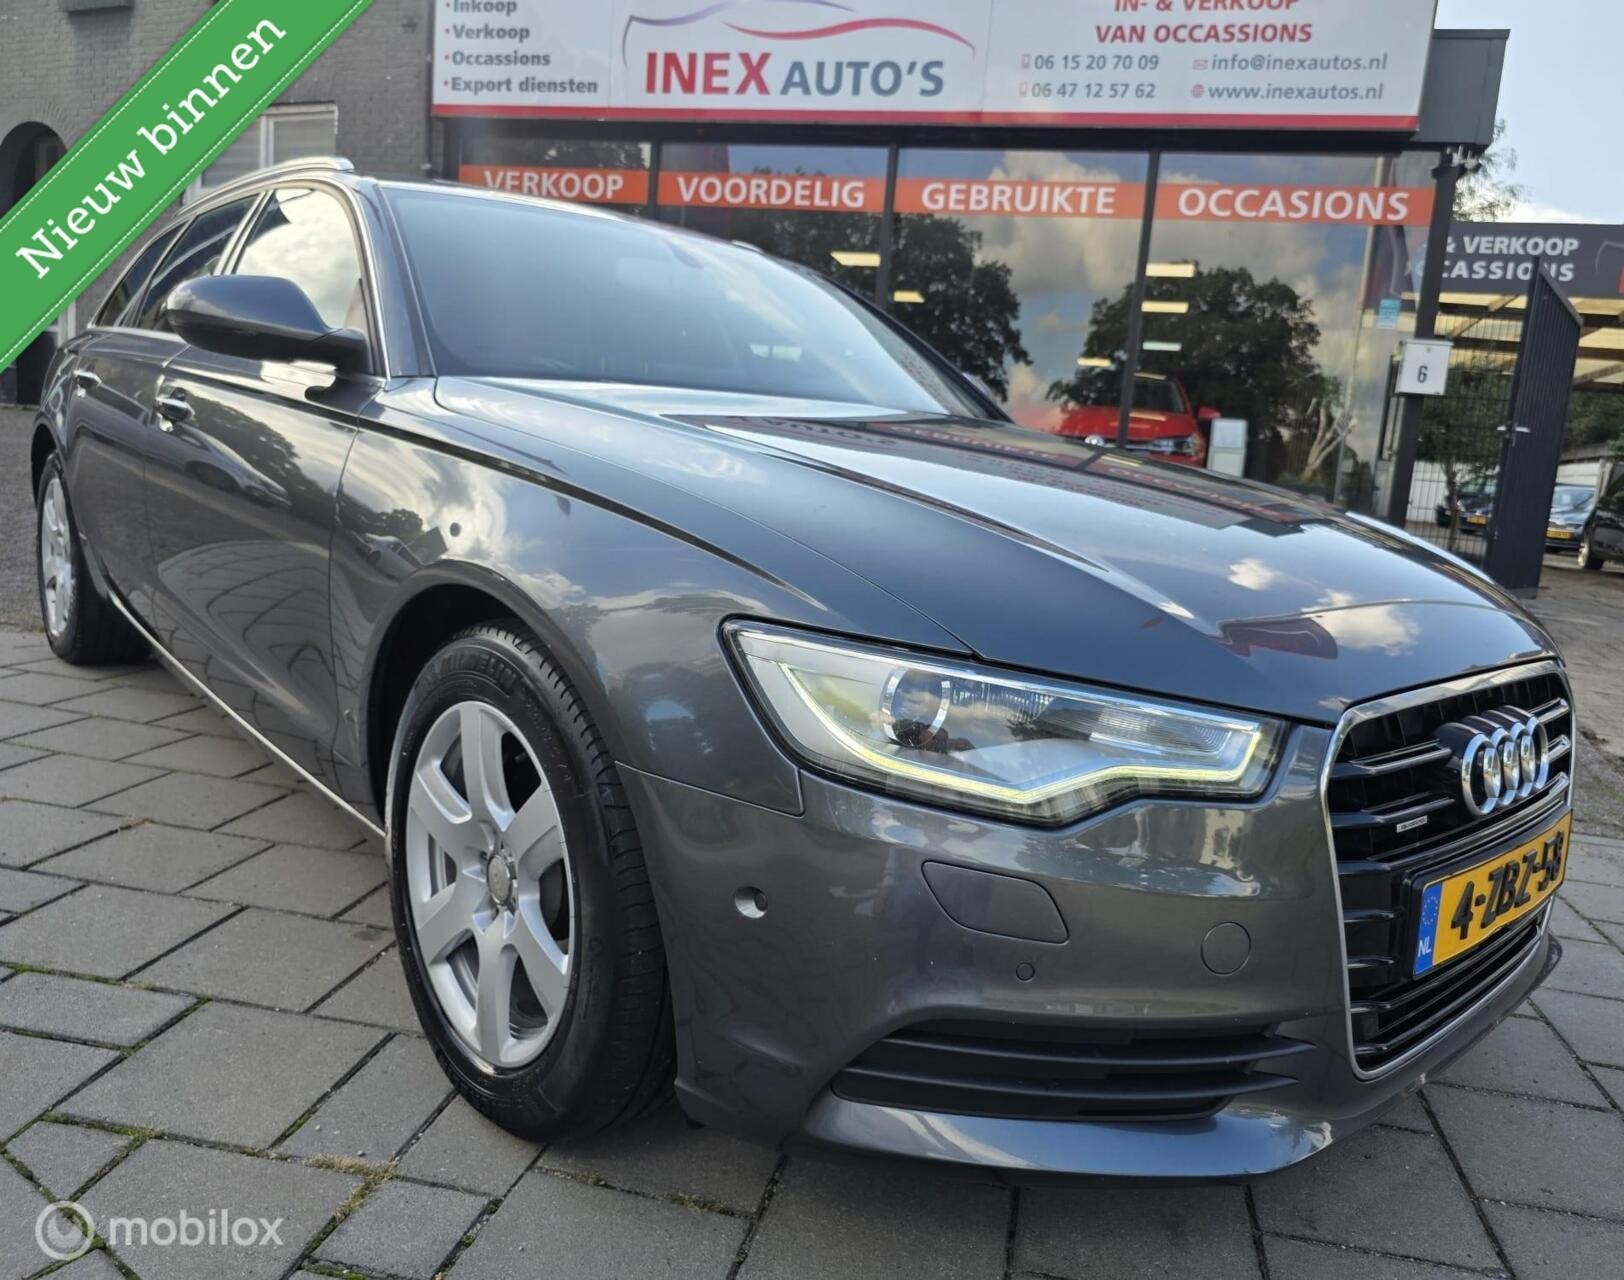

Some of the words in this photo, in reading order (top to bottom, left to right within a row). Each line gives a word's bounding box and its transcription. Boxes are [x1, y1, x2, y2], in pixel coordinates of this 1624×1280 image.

[453, 0, 518, 16] Inkoop
[1114, 0, 1147, 12] IN-
[1155, 0, 1172, 12] &
[1182, 0, 1299, 11] VERKOOP
[452, 24, 530, 43] Verkoop
[1096, 25, 1146, 43] VAN
[1153, 24, 1312, 43] OCCASSIONS
[452, 51, 551, 66] Occassions
[1034, 55, 1054, 70] 06
[1062, 55, 1081, 70] 15
[1086, 55, 1106, 70] 20
[1112, 55, 1133, 70] 70
[1138, 55, 1159, 70] 09
[1211, 53, 1388, 71] info@inexautos.nl
[645, 52, 772, 96] INEX
[779, 60, 944, 97] AUTO'S
[451, 77, 512, 95] Export
[518, 77, 598, 93] diensten
[1031, 83, 1052, 98] 06
[1056, 83, 1077, 98] 47
[1085, 83, 1103, 98] 12
[1109, 83, 1129, 98] 57
[1135, 83, 1156, 98] 62
[1208, 83, 1384, 100] www.inexautos.nl
[484, 170, 624, 199] VERKOOP
[677, 177, 865, 208] VOORDELIG
[922, 182, 1116, 214] GEBRUIKTE
[1178, 188, 1409, 221] OCCASIONS
[1463, 236, 1580, 256] VERKOOP
[1417, 365, 1428, 383] 6
[1417, 935, 1431, 958] NL
